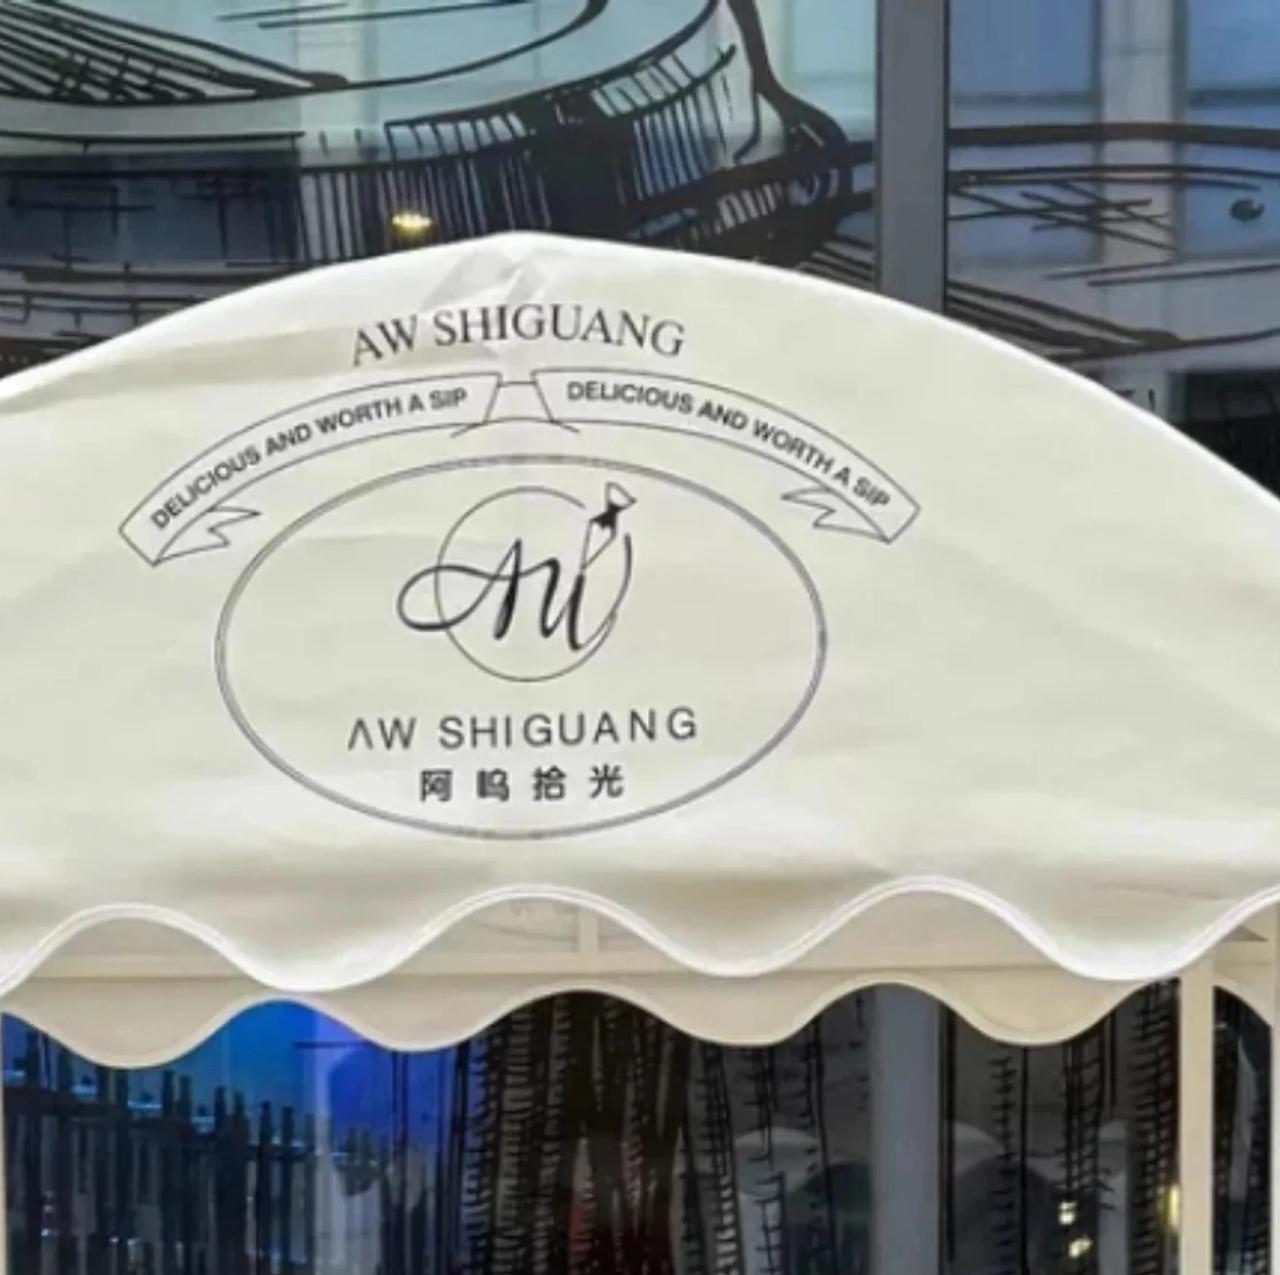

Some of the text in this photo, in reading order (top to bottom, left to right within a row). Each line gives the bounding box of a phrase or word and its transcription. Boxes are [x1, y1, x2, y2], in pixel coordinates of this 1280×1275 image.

[352, 303, 686, 366] AW SHIGUANG
[150, 387, 467, 530] DELICIOUS AND WORTH A SIP
[567, 381, 891, 507] DELICIOUS AND WORTH A SIP
[438, 706, 698, 750] SHIGUANG
